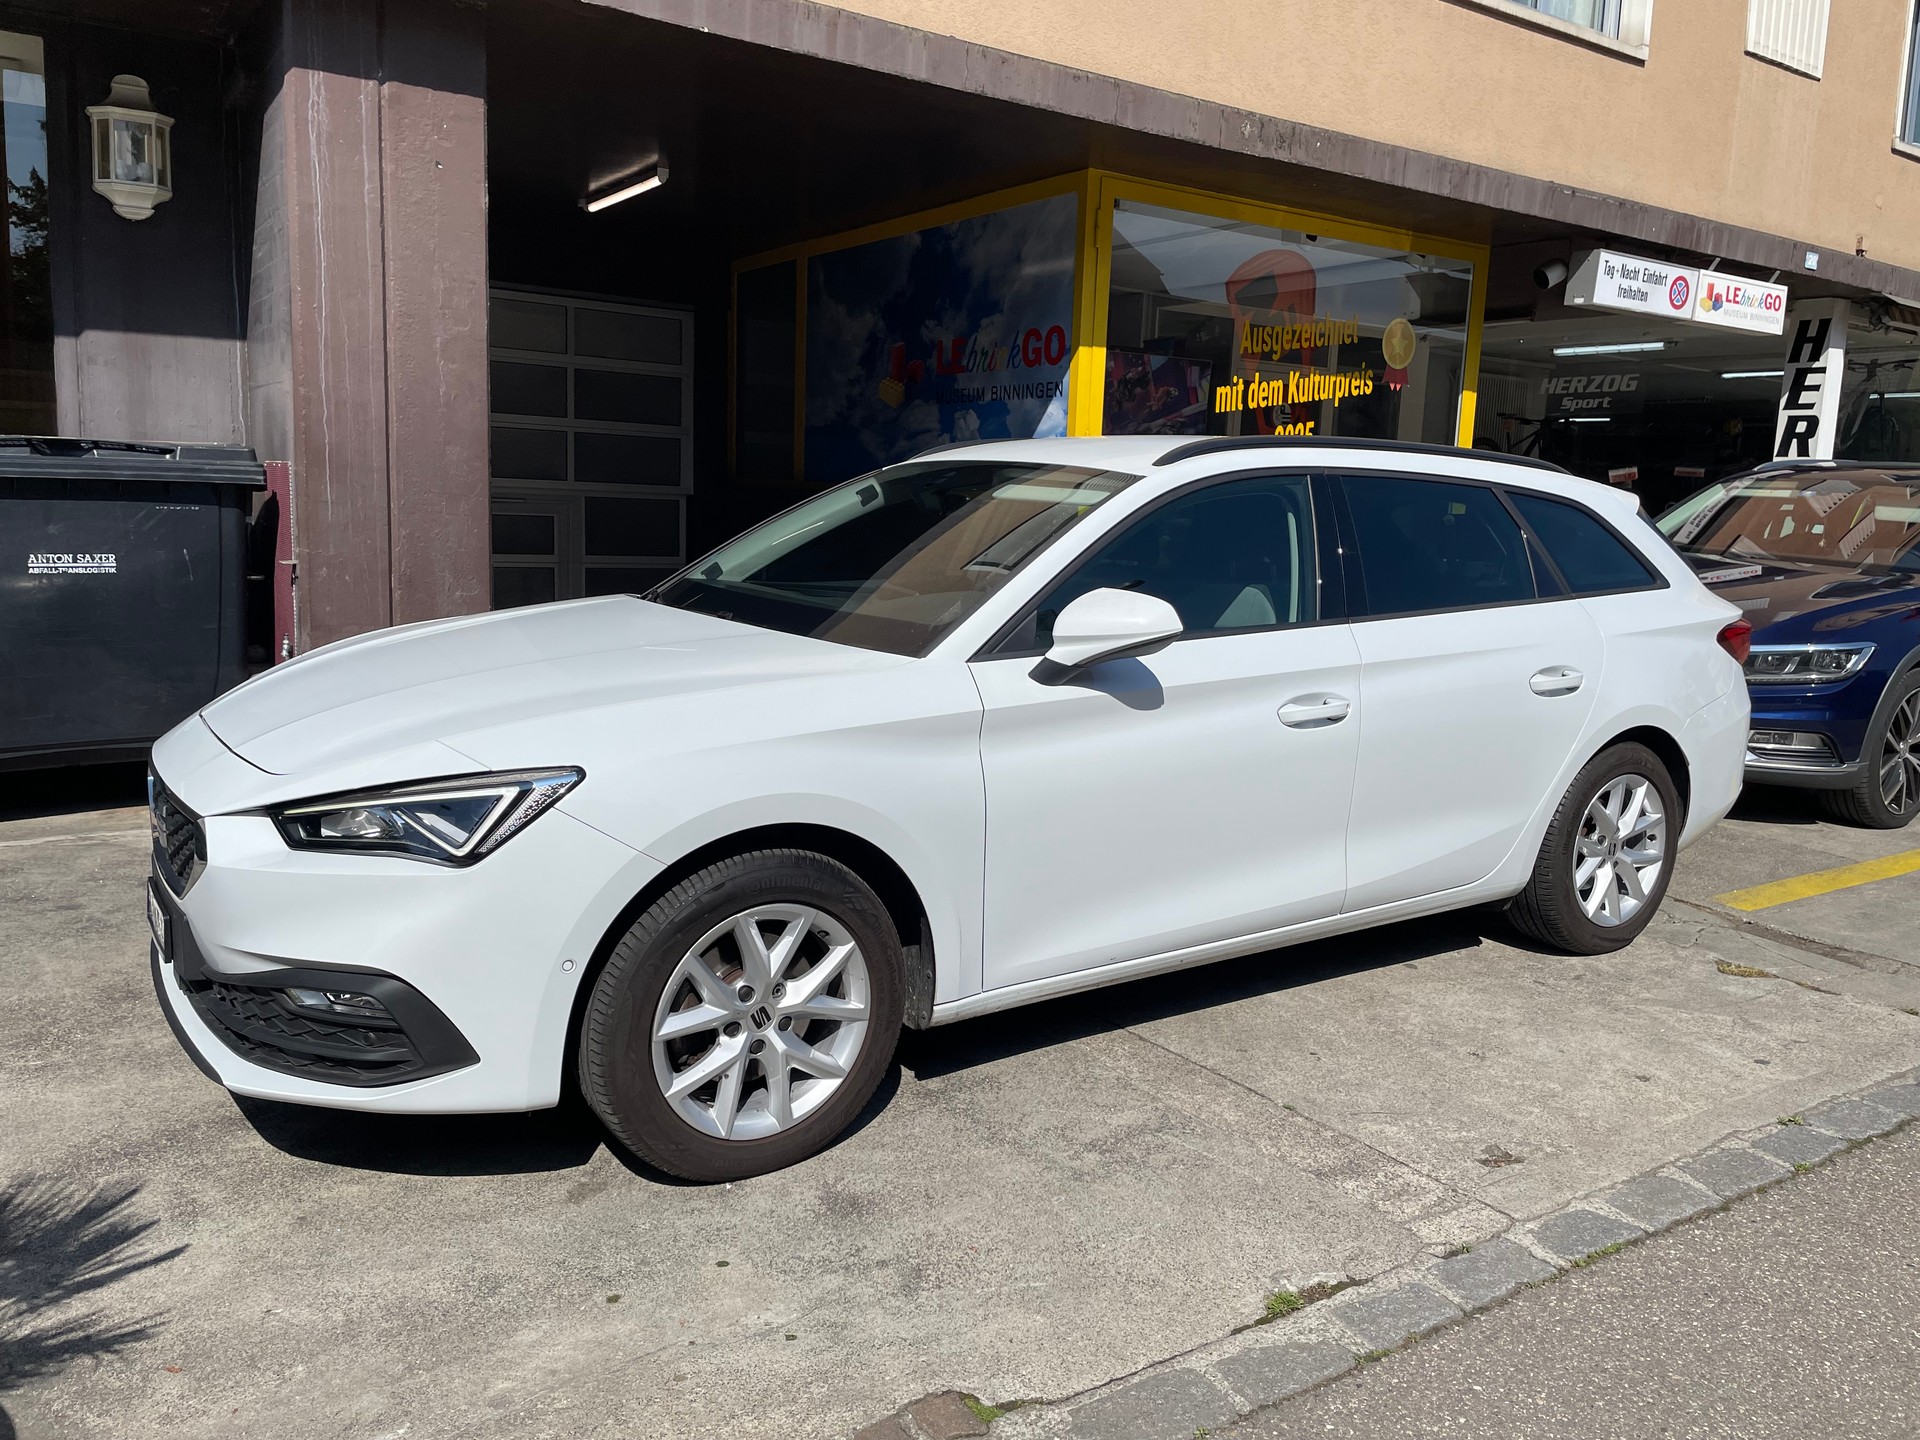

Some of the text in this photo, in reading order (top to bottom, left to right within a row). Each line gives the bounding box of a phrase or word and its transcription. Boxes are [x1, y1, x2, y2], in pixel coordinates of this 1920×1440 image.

[1603, 259, 1616, 280] Tag
[1619, 263, 1641, 282] Nacht
[1642, 267, 1668, 287] Einfahrt
[1617, 283, 1649, 303] freihalten
[1725, 284, 1782, 312] LEbrickGO
[1723, 308, 1780, 325] MUSEUM BINNINGEN
[1240, 312, 1360, 361] Ausgezeichnet
[936, 381, 1064, 404] MUSEUM BINNINGEN
[1215, 362, 1374, 413] mit dem Kulturpreis
[1540, 373, 1640, 395] HERZOG
[1560, 396, 1612, 412] Sport
[27, 553, 116, 564] ANTON SAXER
